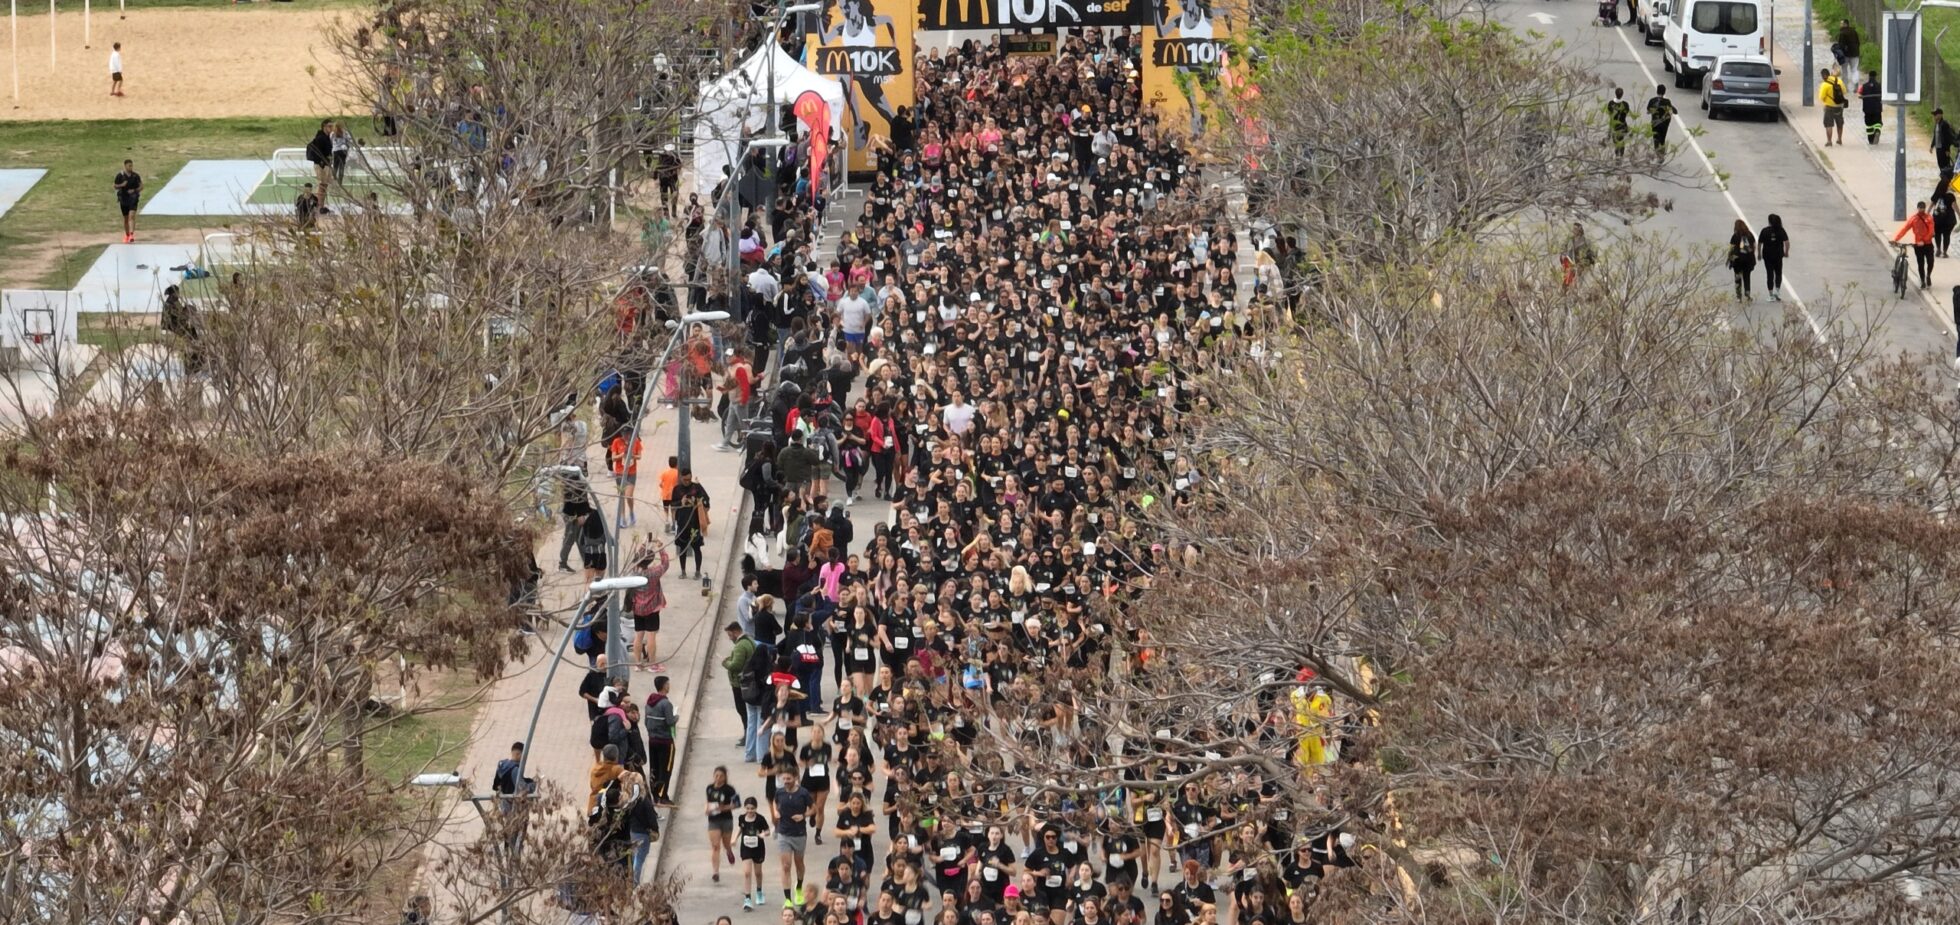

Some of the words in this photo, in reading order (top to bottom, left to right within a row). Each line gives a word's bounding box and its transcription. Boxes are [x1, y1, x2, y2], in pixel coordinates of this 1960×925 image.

[1086, 2, 1102, 13] de
[1103, 0, 1130, 12] ser
[826, 49, 896, 73] M10K
